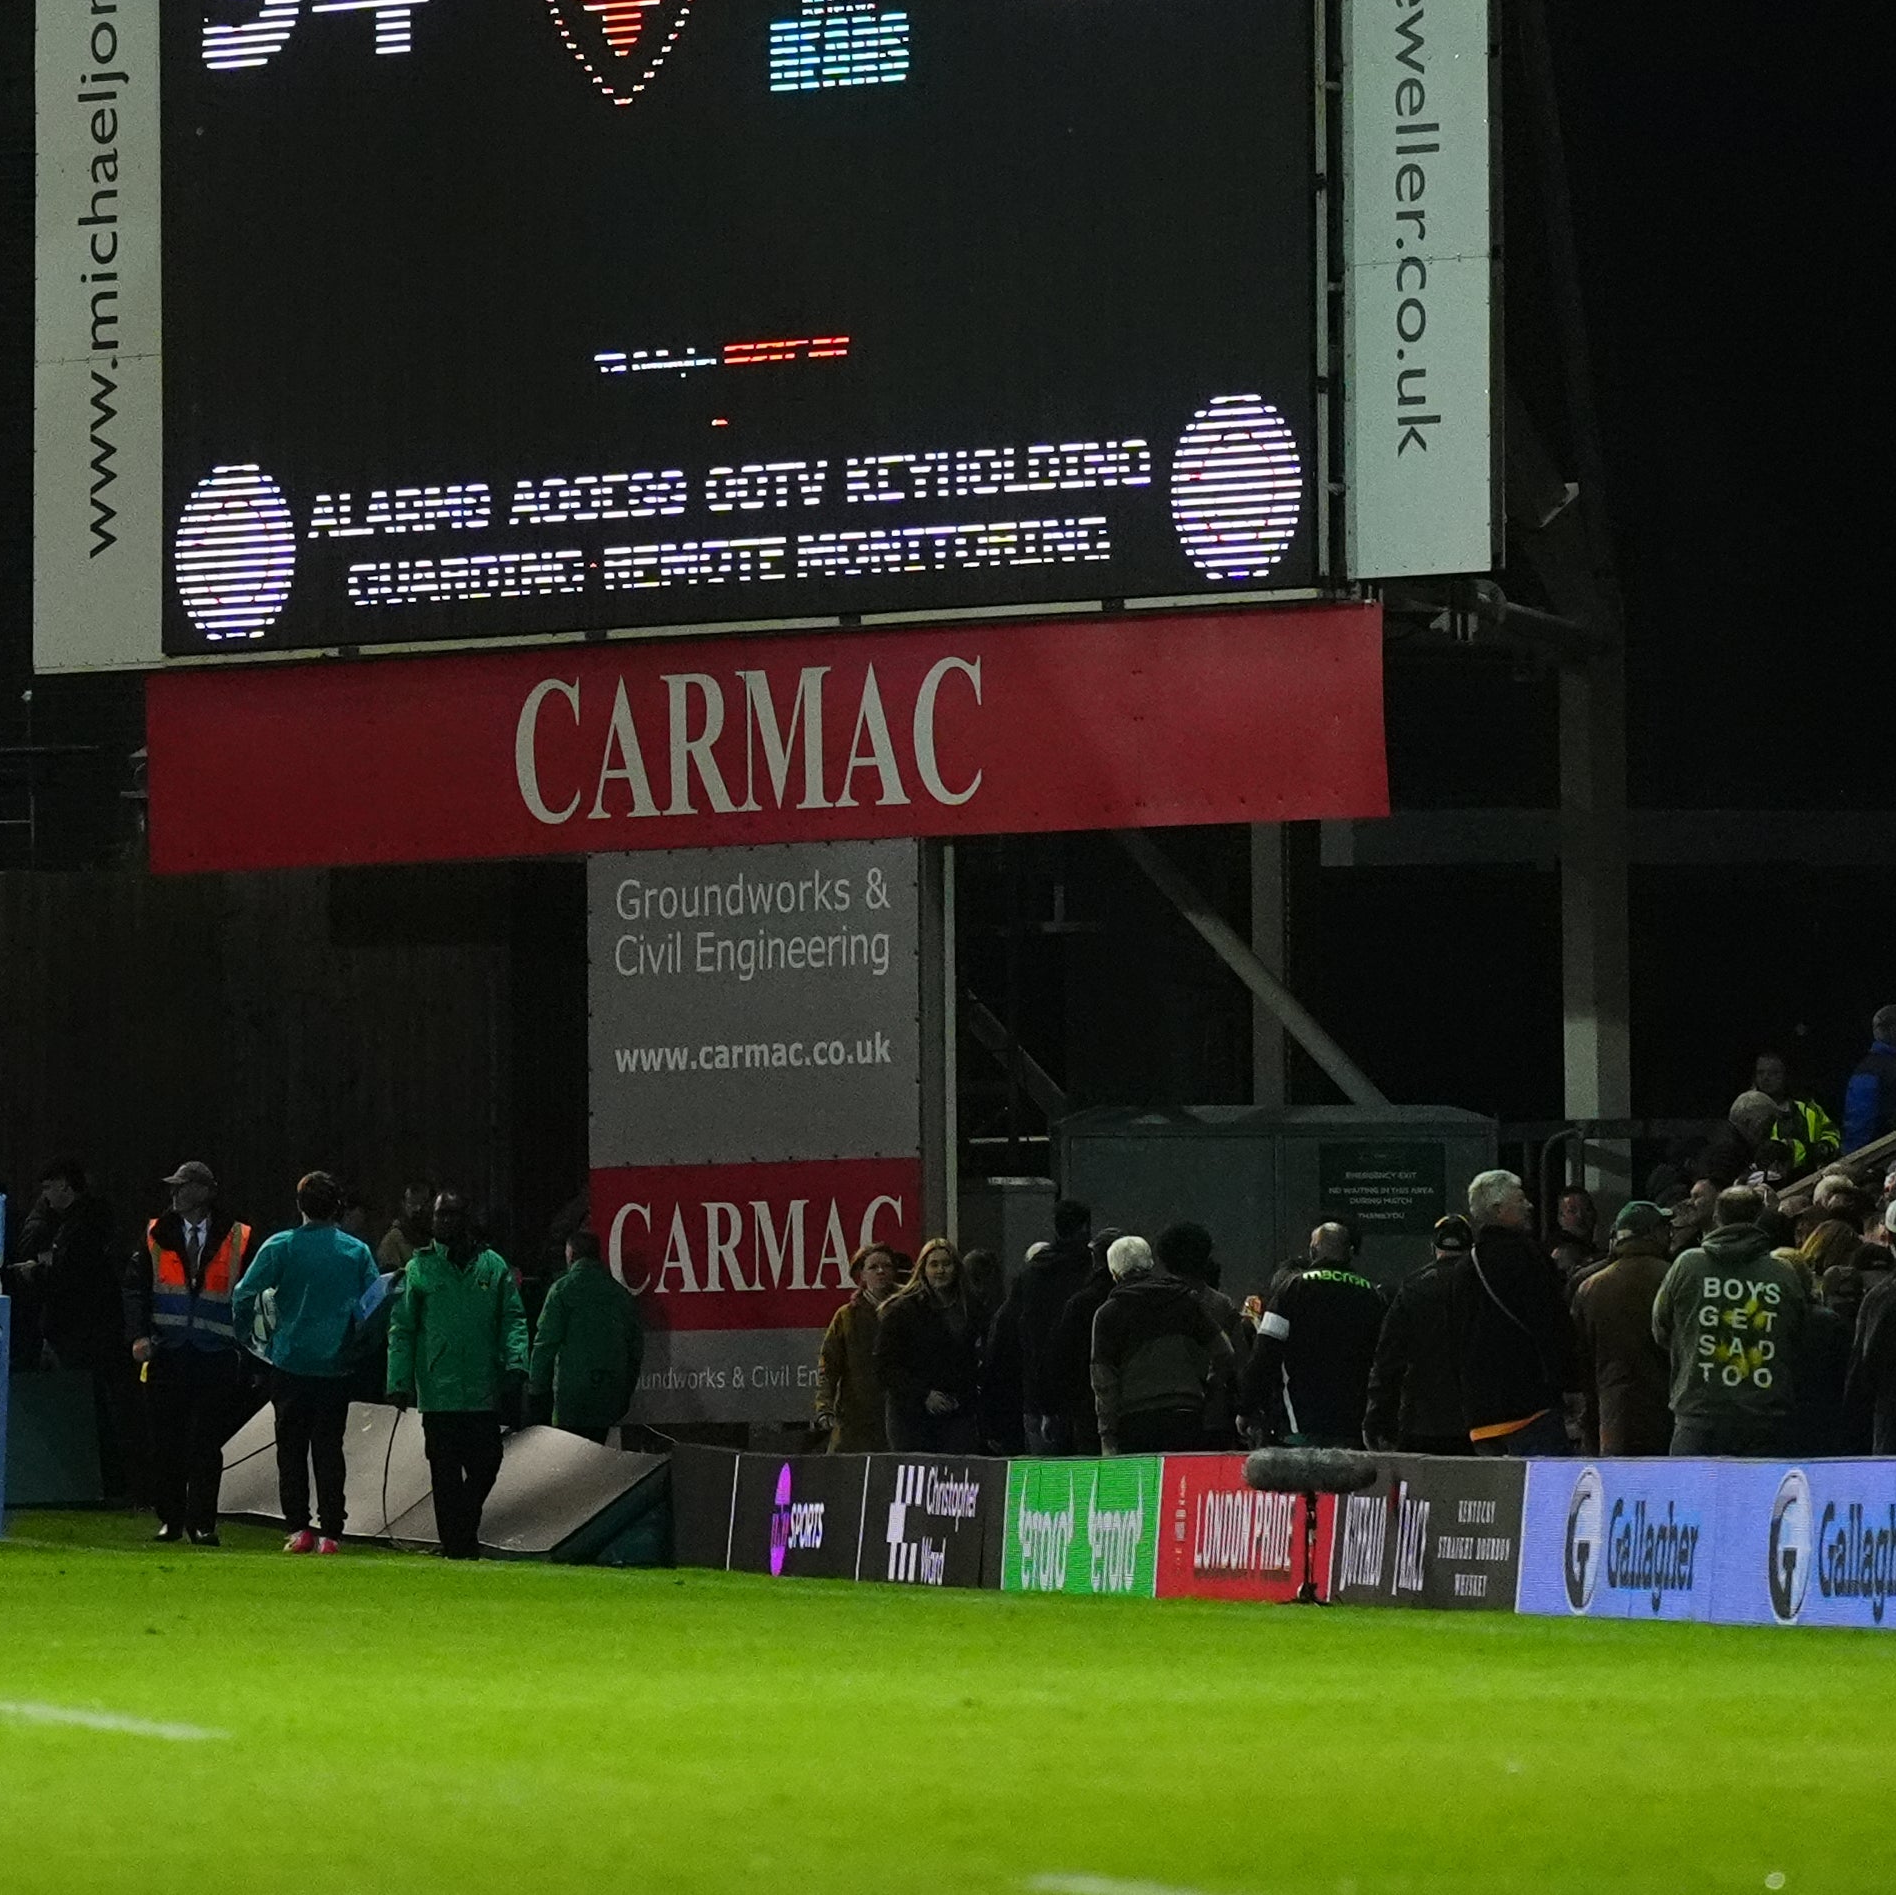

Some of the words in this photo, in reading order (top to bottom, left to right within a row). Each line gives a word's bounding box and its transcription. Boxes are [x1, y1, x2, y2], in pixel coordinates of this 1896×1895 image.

[604, 536, 787, 590] REMOTE
[797, 515, 1111, 579] MONITORING
[514, 655, 983, 825] CARMAC
[616, 870, 850, 921] Groundworks
[866, 867, 892, 911] &
[615, 931, 682, 976] Civil
[696, 931, 891, 981] Engineering
[615, 1031, 892, 1073] www.carmac.co.uk
[1302, 1269, 1372, 1290] macron
[1703, 1277, 1781, 1305] BOYS
[1699, 1305, 1778, 1333] GET
[1698, 1335, 1775, 1361] SAD
[732, 1366, 745, 1390] &
[751, 1364, 790, 1388] Civil
[1698, 1362, 1773, 1389] TOO
[926, 1465, 980, 1533] Christopher
[788, 1502, 825, 1550] SPORTS
[1193, 1490, 1254, 1571] LONDON
[1251, 1491, 1297, 1571] PRIDE
[920, 1535, 947, 1586] Ward
[1608, 1497, 1700, 1615] Gallagher
